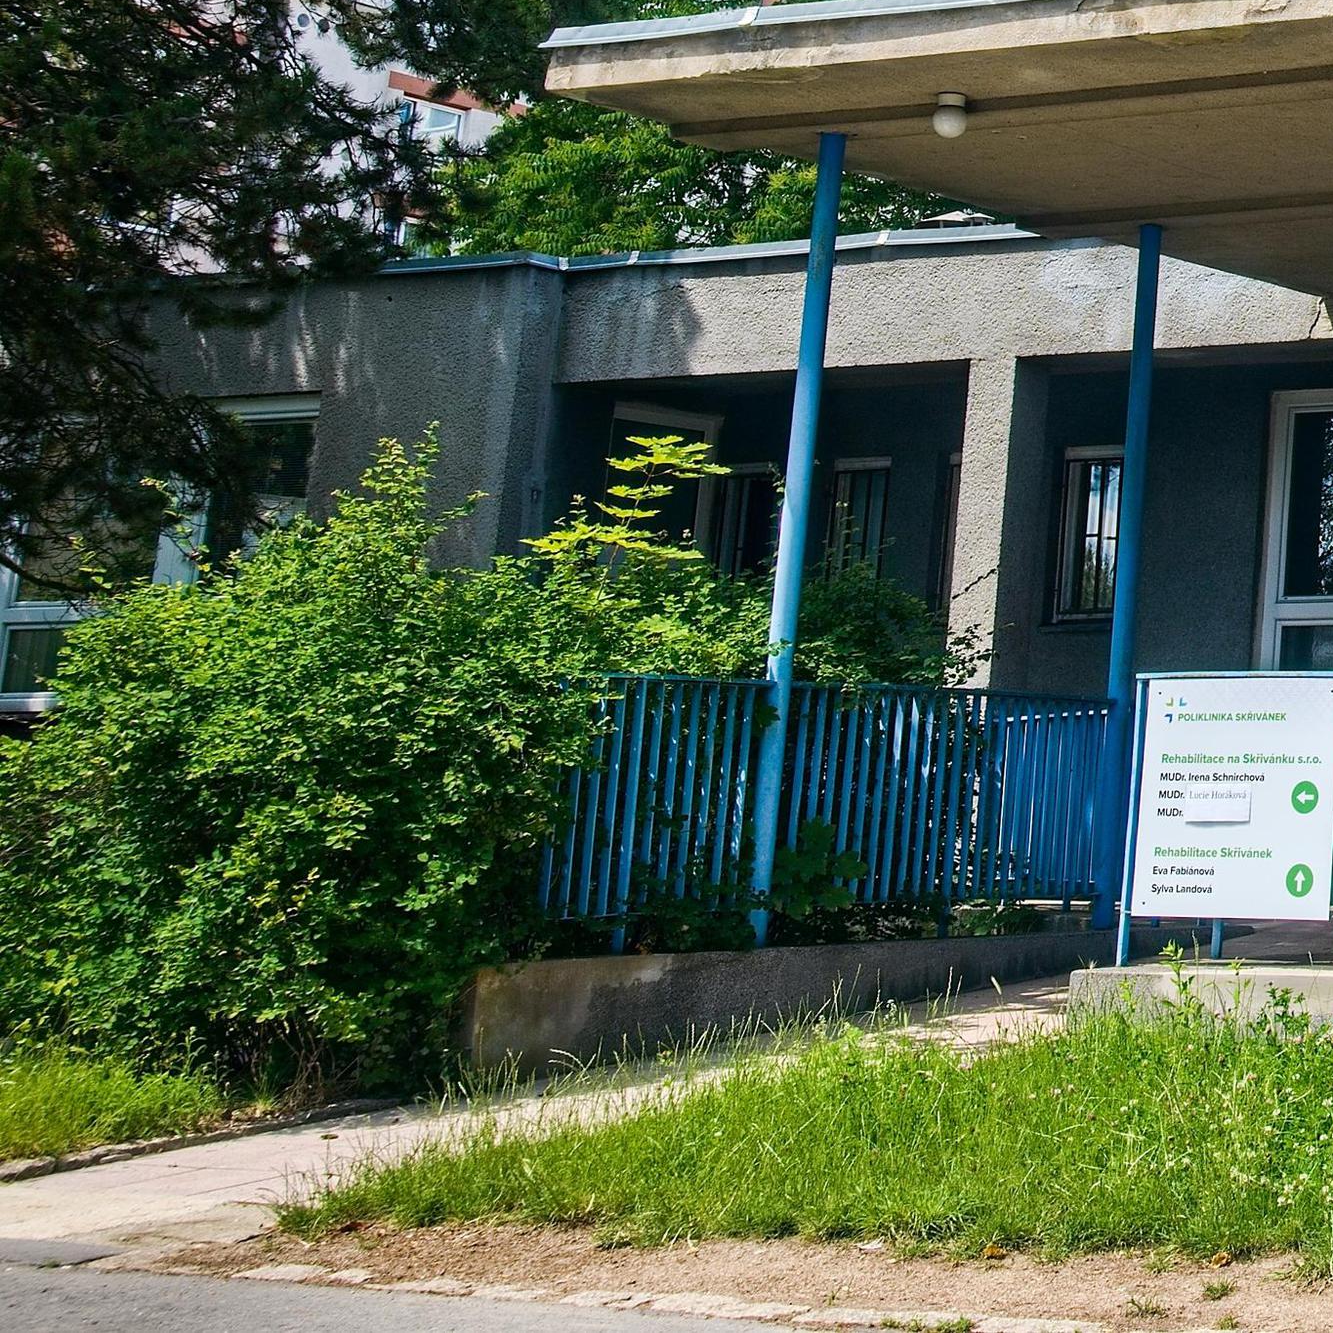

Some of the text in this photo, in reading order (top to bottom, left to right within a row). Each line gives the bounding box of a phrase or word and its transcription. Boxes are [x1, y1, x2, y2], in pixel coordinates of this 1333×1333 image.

[1178, 711, 1286, 722] POLIKLINIKA SKŘIVÁNEK
[1162, 753, 1224, 763] Rehabilitace
[1298, 756, 1321, 764] s.r.o.
[1160, 773, 1186, 782] MUDr.
[1189, 773, 1210, 782] Irena
[1159, 790, 1185, 799] MUDr.
[1157, 808, 1183, 816] MUDr.
[1154, 847, 1272, 858] Rehabilitace Skřivánek
[1153, 866, 1214, 875] Eva Fabiánová
[1151, 884, 1212, 895] Sylva Landová
